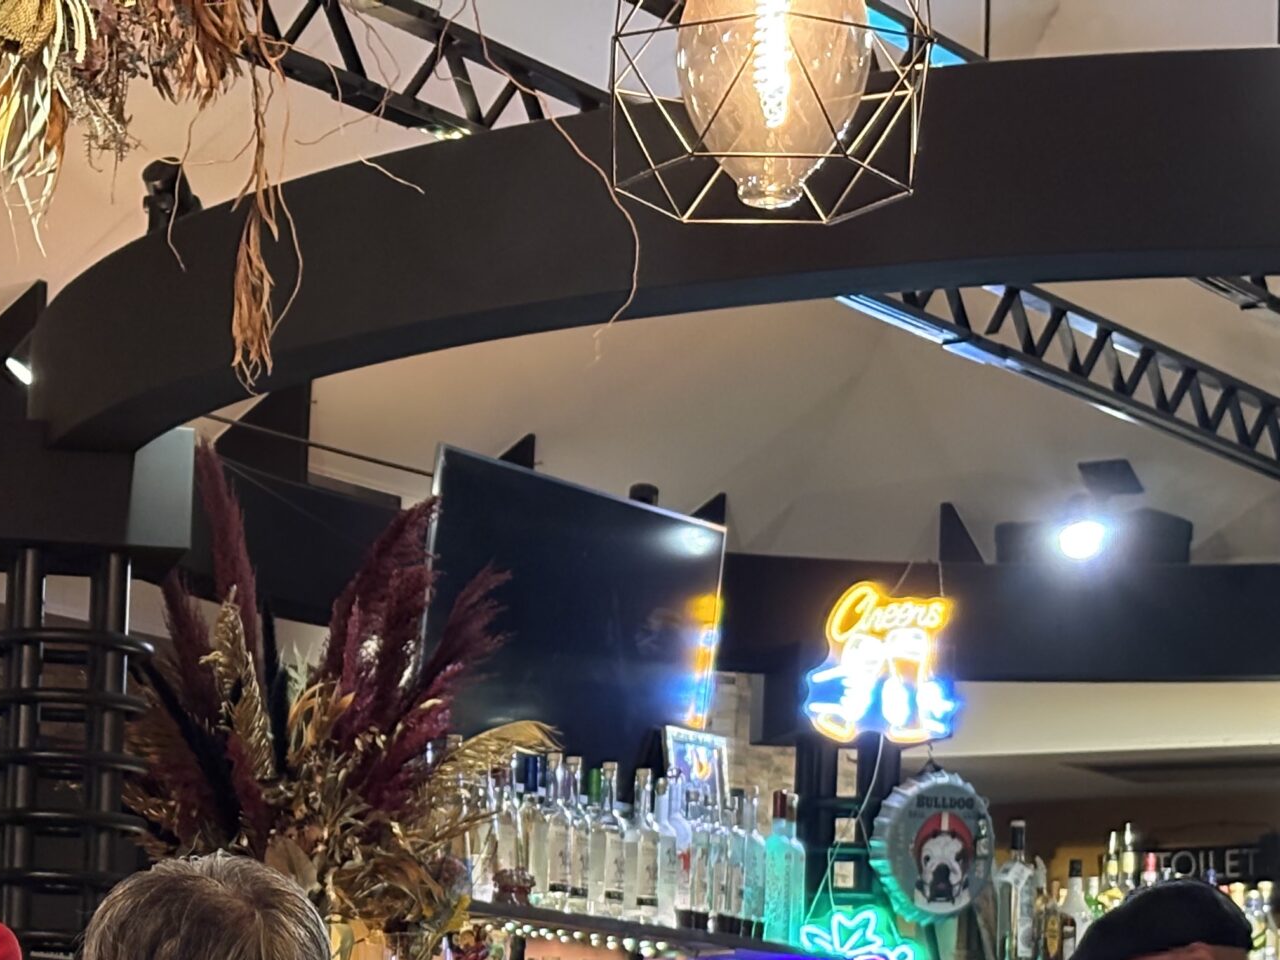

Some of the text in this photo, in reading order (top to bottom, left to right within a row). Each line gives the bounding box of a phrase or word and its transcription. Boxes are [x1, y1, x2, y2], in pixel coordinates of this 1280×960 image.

[830, 585, 946, 643] Cheers
[916, 793, 975, 810] BULLDOG
[1157, 849, 1261, 879] TOILET
